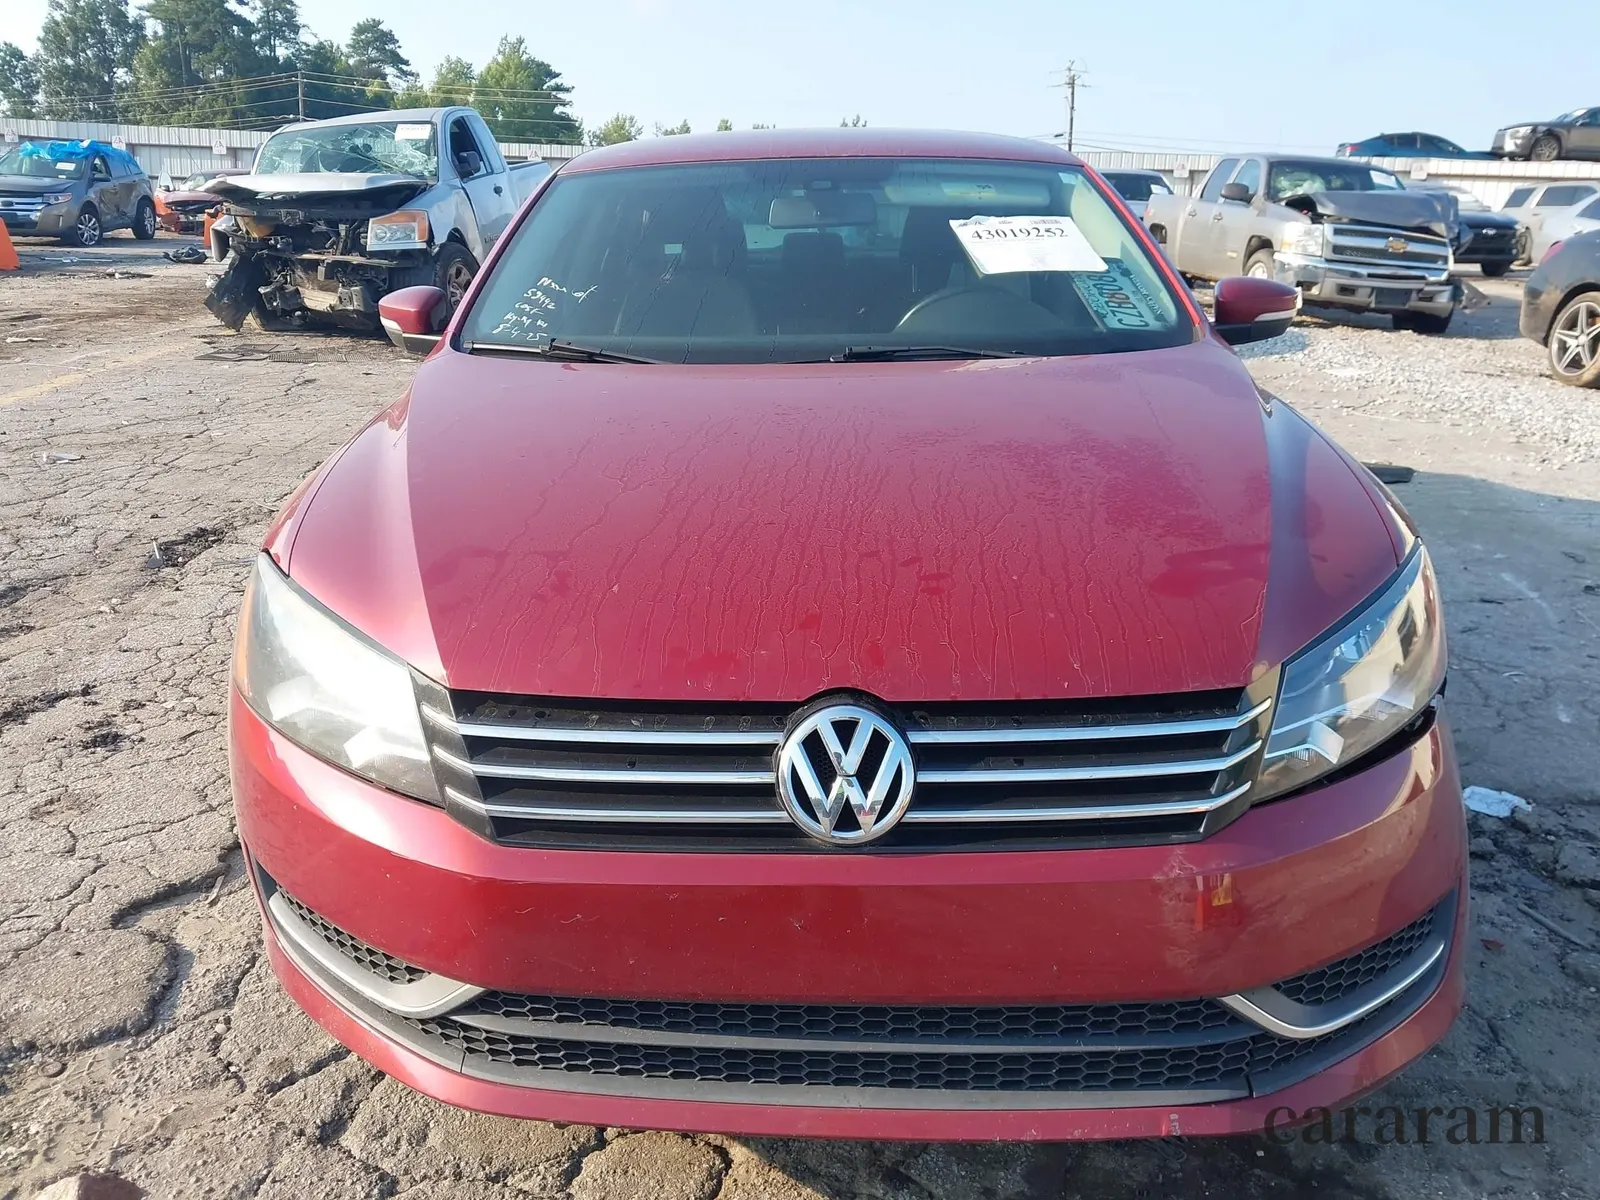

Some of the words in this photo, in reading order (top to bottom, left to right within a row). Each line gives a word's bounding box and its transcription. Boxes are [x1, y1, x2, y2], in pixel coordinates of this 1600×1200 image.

[971, 227, 1069, 240] 43019252
[1086, 270, 1150, 328] CZB808
[780, 706, 913, 842] VW
